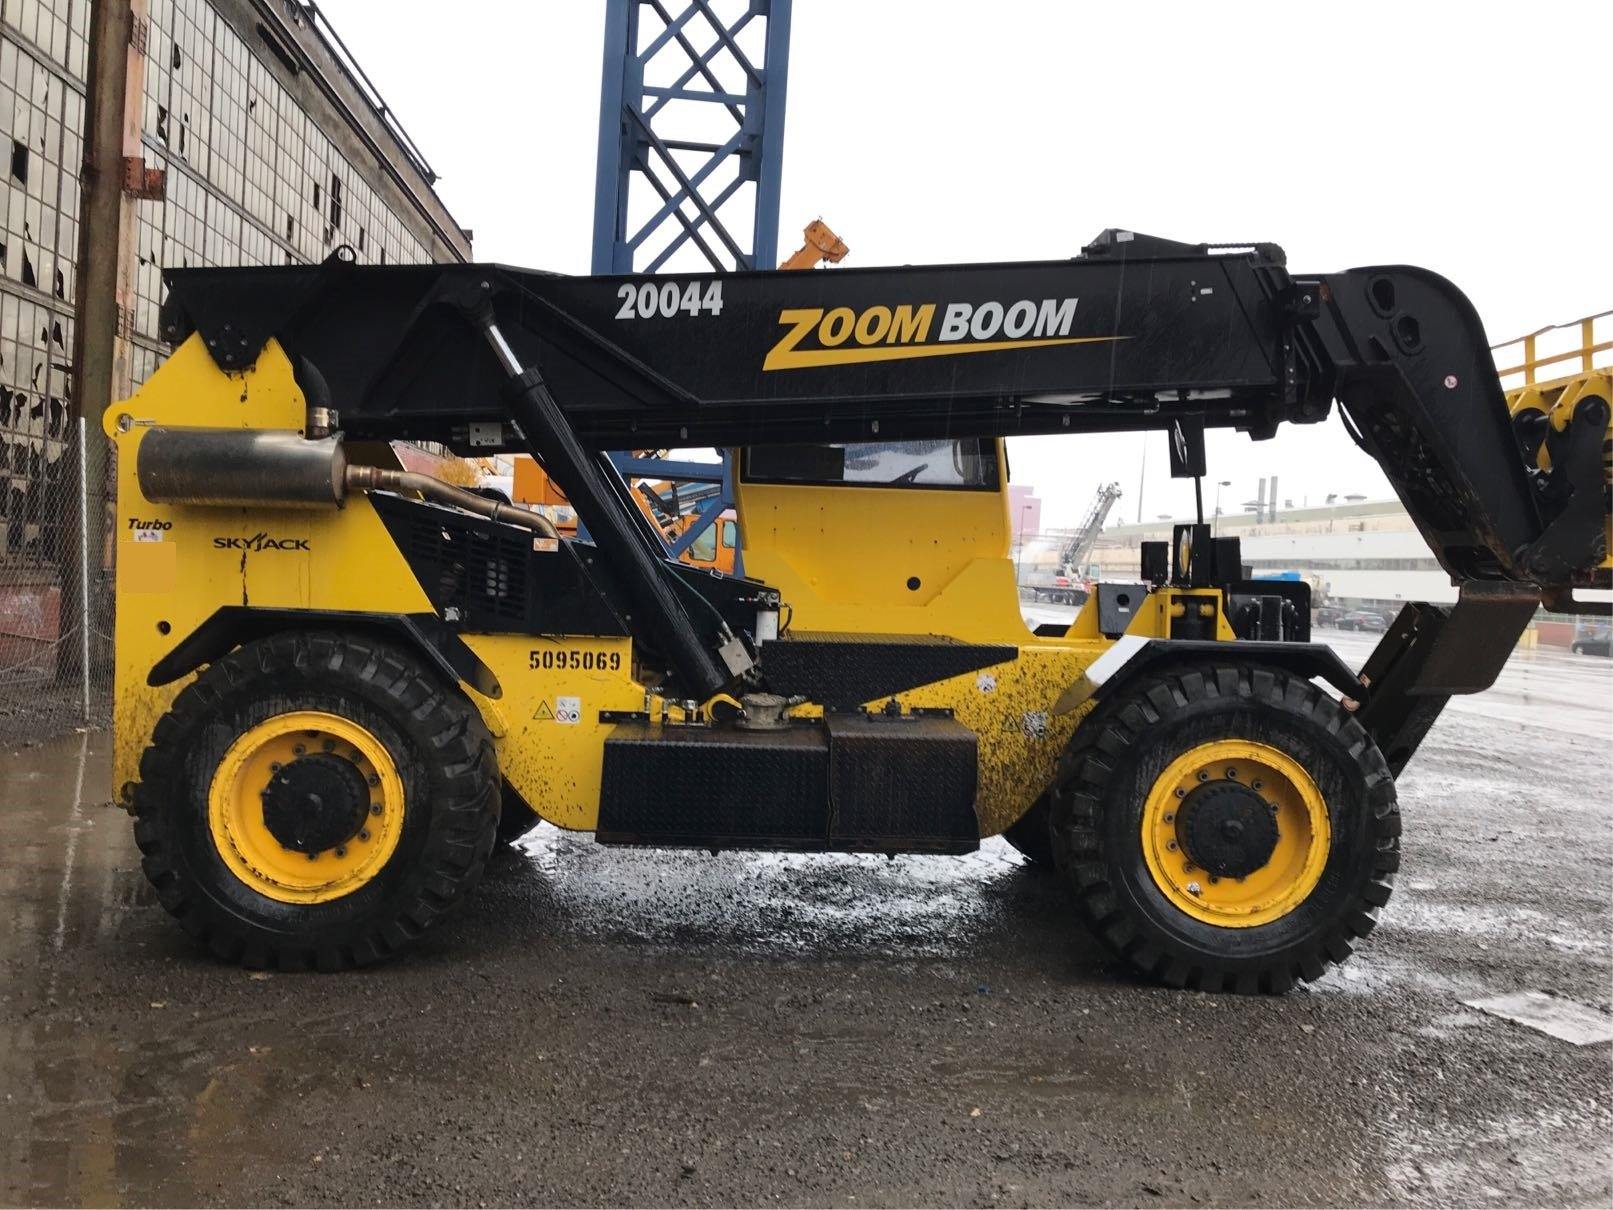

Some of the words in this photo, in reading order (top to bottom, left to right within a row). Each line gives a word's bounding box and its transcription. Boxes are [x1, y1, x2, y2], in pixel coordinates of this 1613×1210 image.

[615, 280, 723, 320] 20044
[762, 303, 937, 370] ZOOM
[939, 298, 1078, 342] BOOM
[128, 518, 172, 530] Turbo
[213, 532, 310, 552] SKYJACK
[530, 651, 620, 670] 5095069
